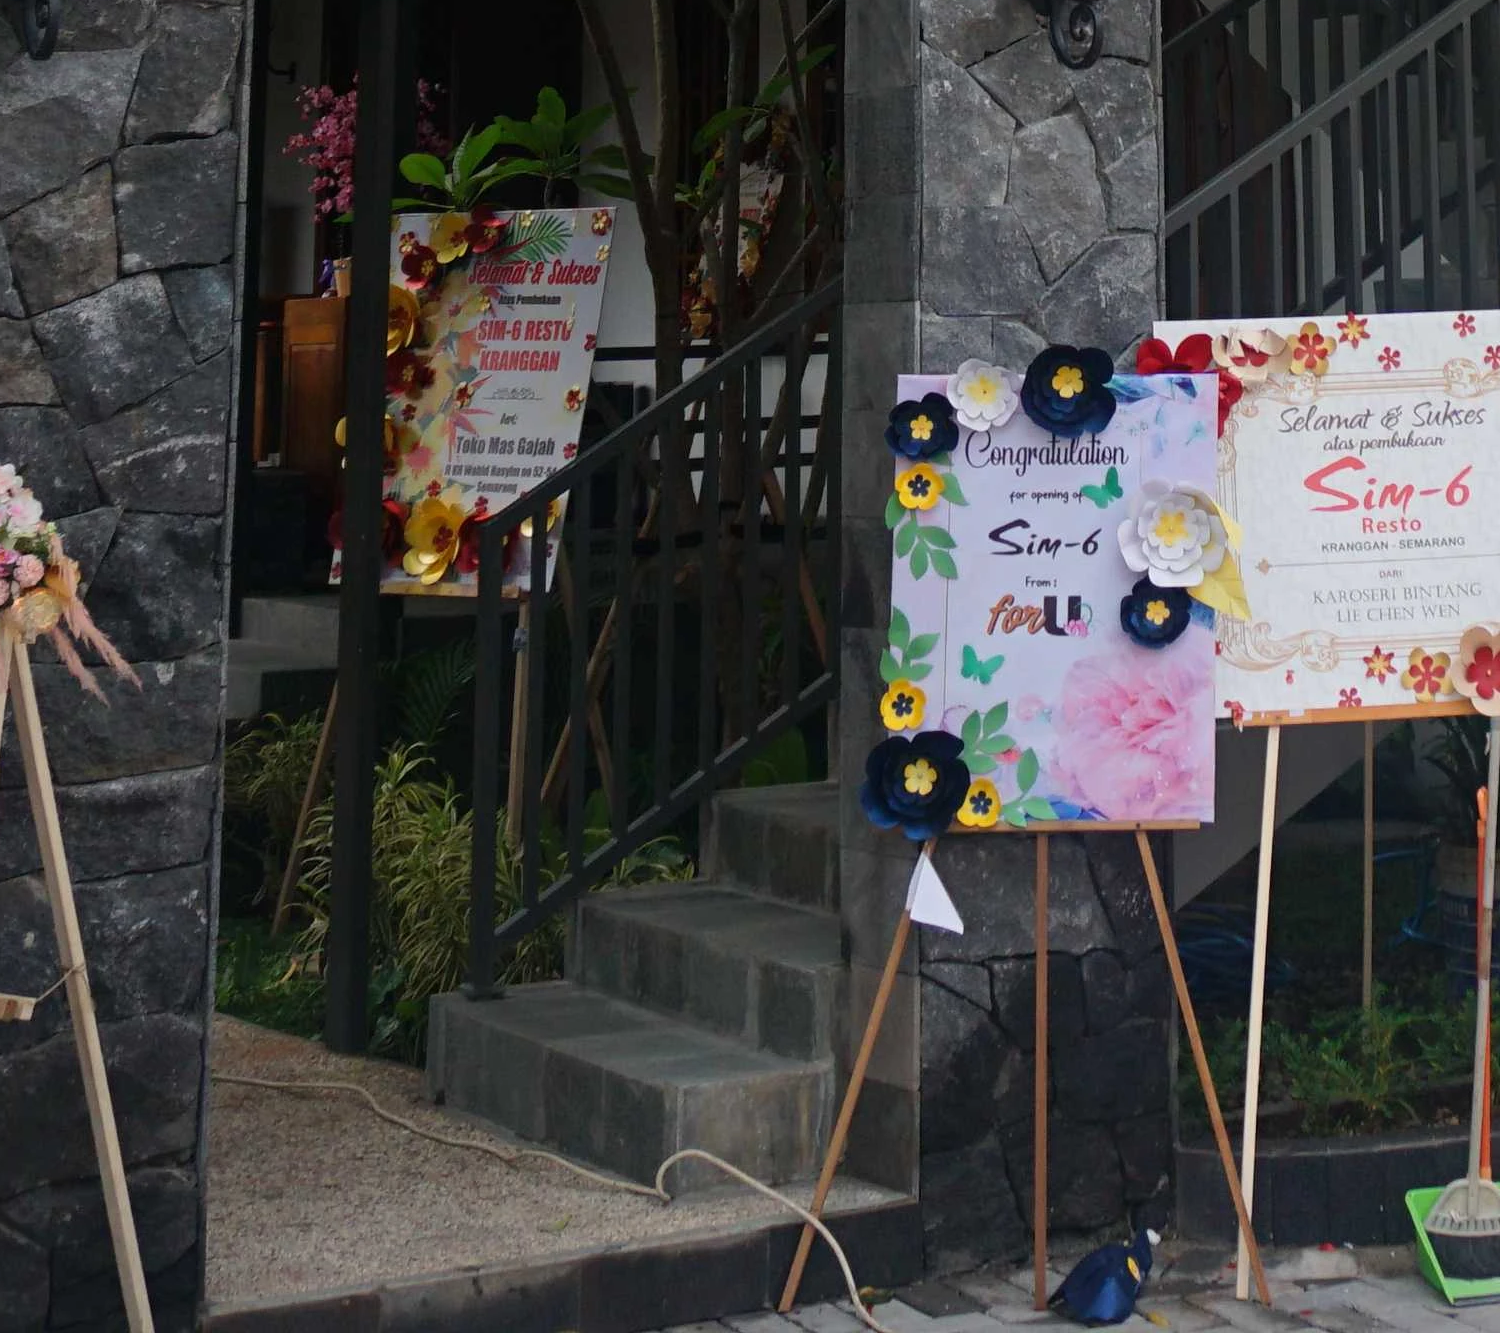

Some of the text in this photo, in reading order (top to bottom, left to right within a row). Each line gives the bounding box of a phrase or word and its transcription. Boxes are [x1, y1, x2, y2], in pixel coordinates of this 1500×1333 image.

[469, 259, 602, 285] Selamat & Sukses
[478, 349, 560, 372] KRANGGAN
[1279, 400, 1486, 433] Selamat & Sukses
[456, 436, 555, 457] Toko Mas Gajah
[965, 431, 1130, 477] Congratulation
[1323, 430, 1446, 455] atas pembukaan
[1009, 490, 1025, 503] for
[1031, 489, 1069, 503] opening
[1303, 455, 1473, 515] Sim-6
[1362, 516, 1422, 534] Resto
[988, 518, 1103, 560] Sim-6
[1321, 540, 1389, 553] KRANGGAN
[1399, 536, 1466, 550] SEMARANG
[1313, 582, 1482, 605] KAROSERI BINTANG
[1337, 604, 1461, 623] LIE CHEN WEN
